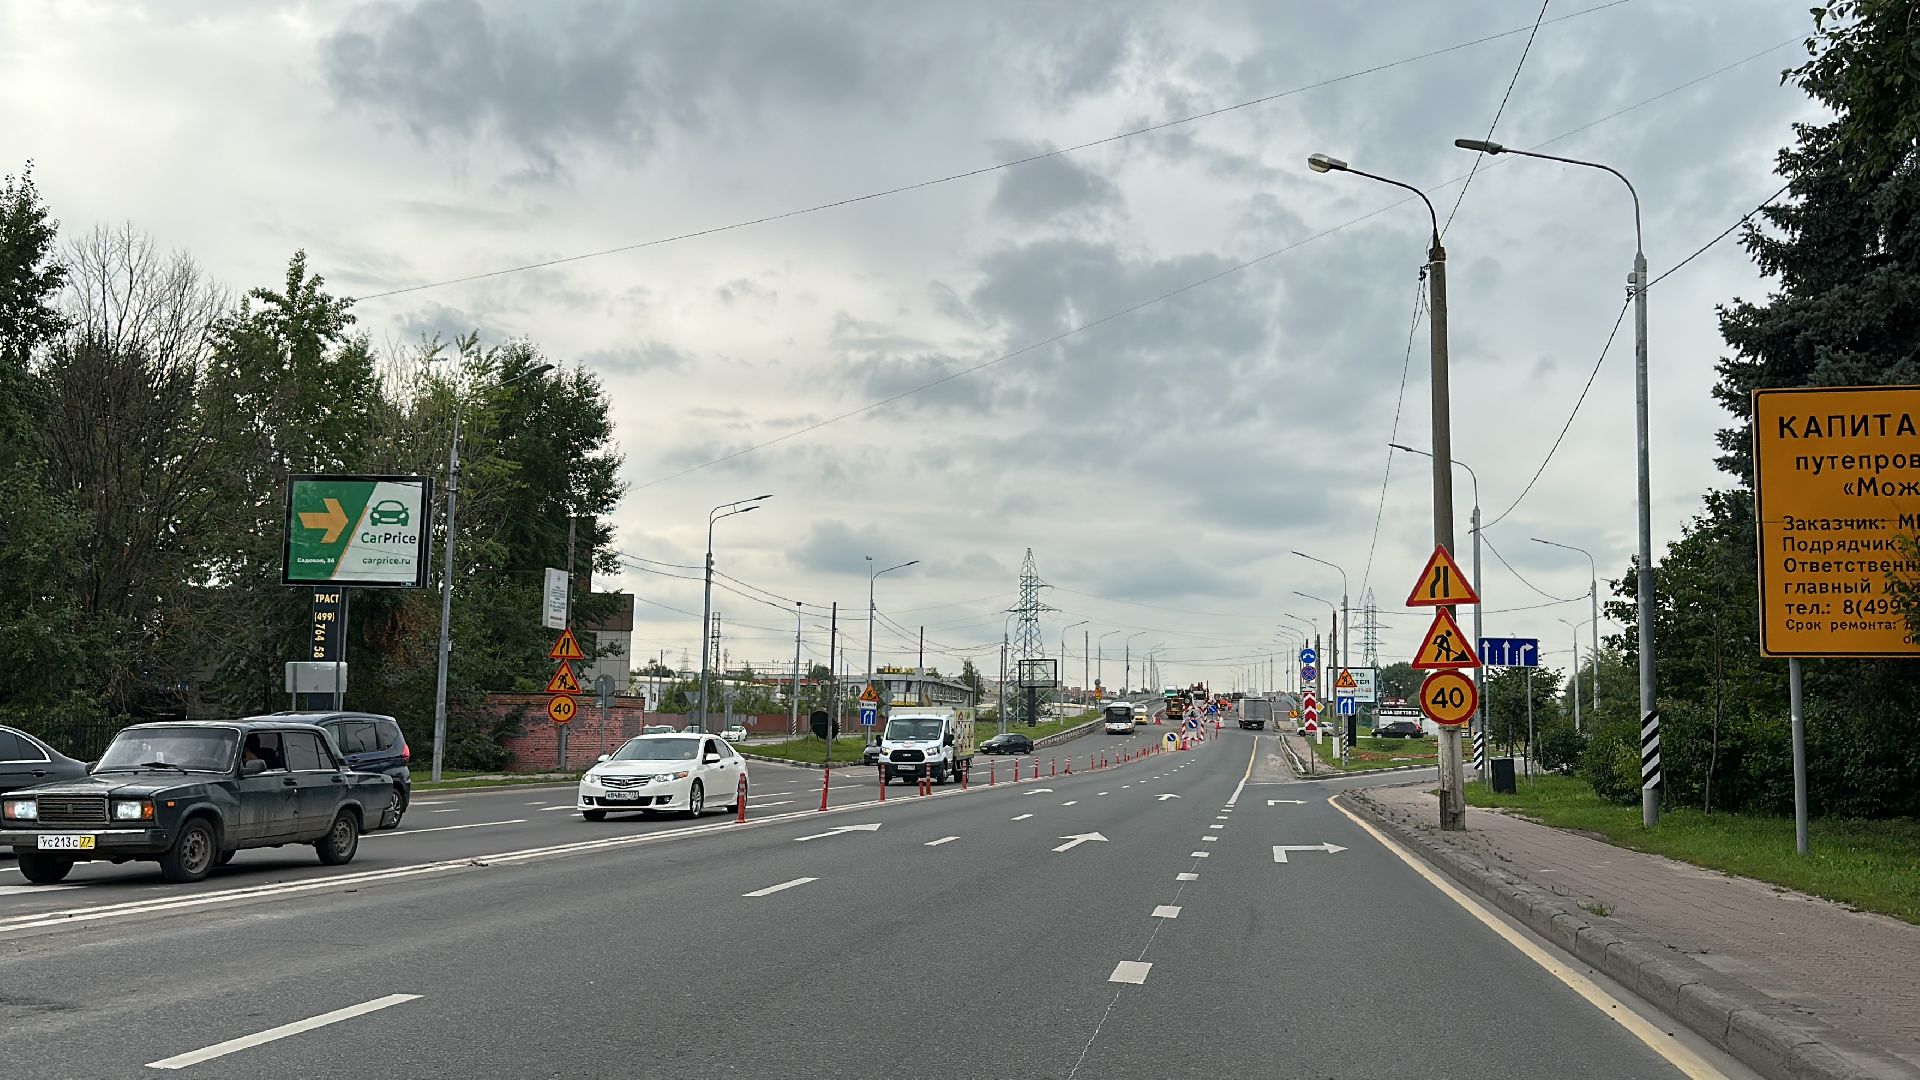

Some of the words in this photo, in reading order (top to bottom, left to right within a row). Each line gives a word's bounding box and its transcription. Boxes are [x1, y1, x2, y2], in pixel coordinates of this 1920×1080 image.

[1778, 413, 1917, 439] КАПИТА
[1783, 515, 1886, 531] Заказчик:
[361, 532, 417, 544] CarPrice
[1782, 536, 1902, 555] Подрядчик:
[362, 558, 411, 566] carprice.ru
[1783, 557, 1920, 573] Ответственн
[1783, 578, 1871, 595] главный
[314, 594, 339, 604] ТРАСТ
[1785, 603, 1831, 615] тел.:
[314, 611, 335, 622] (499)
[314, 623, 326, 641] 764
[1785, 619, 1821, 632] Срок
[1830, 621, 1897, 633] ремонта:
[313, 646, 324, 658] 58
[1431, 686, 1465, 709] 40
[553, 703, 571, 715] 40
[81, 836, 91, 845] 77
